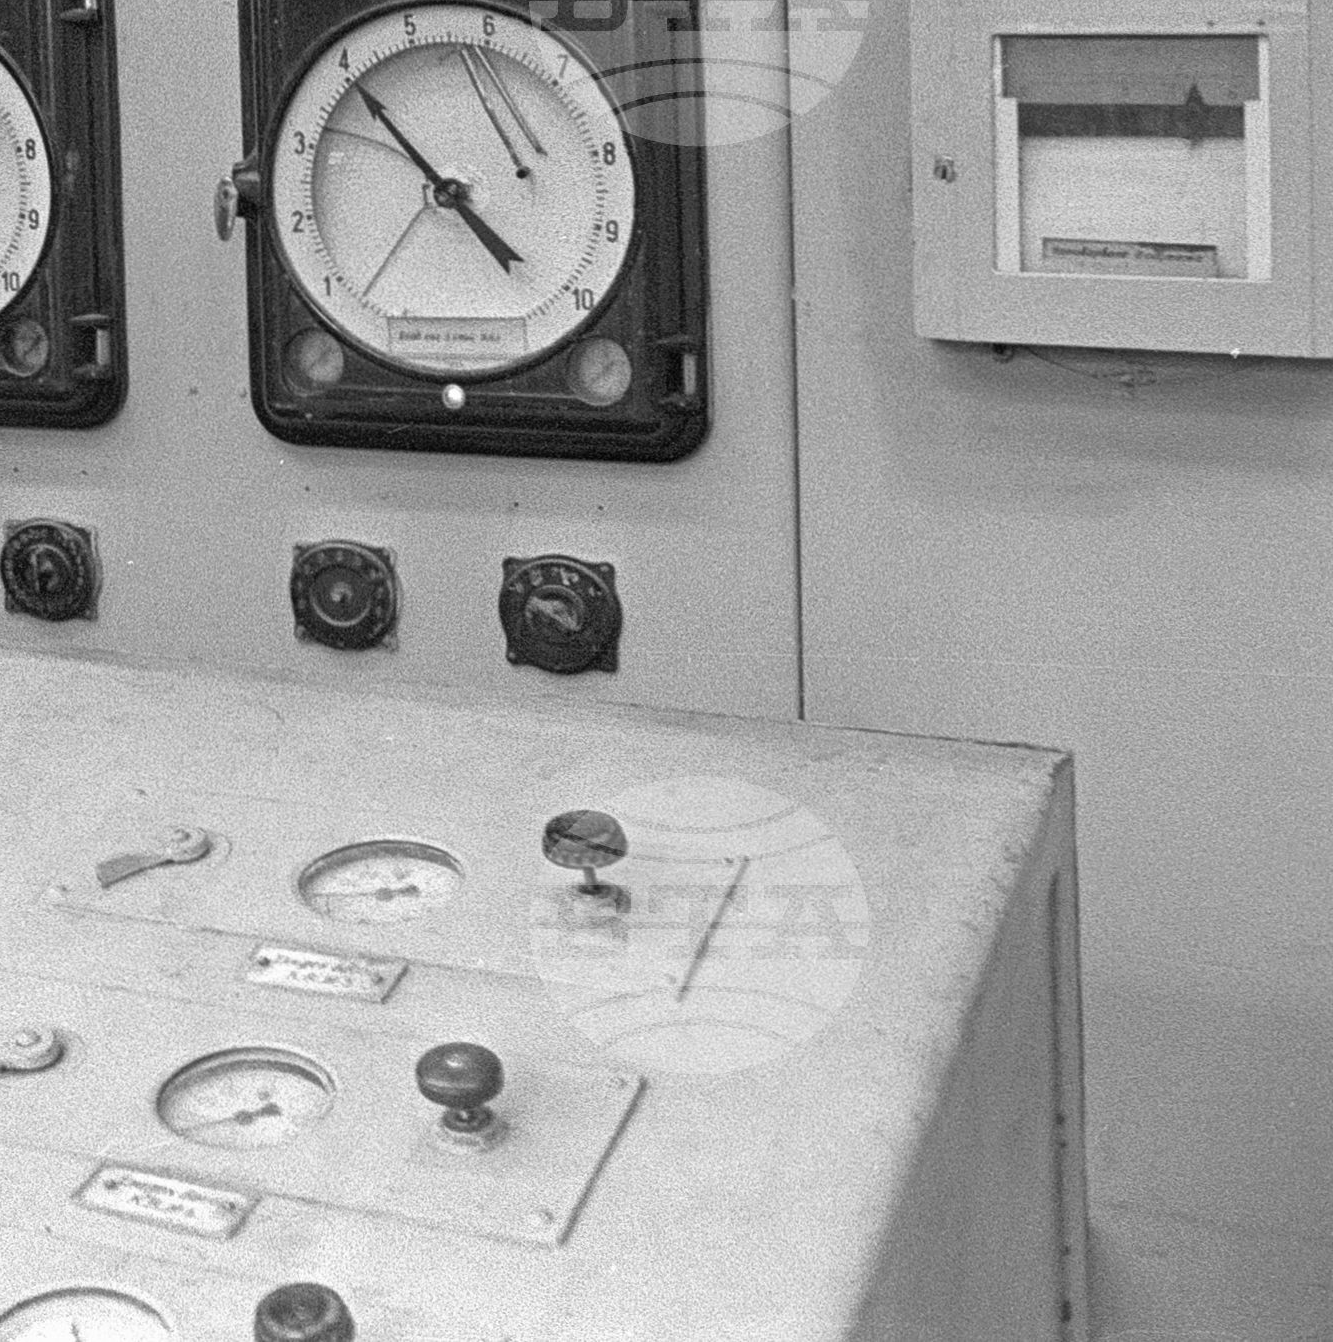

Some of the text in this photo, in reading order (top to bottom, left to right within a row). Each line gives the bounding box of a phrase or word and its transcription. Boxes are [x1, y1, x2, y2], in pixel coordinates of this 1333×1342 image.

[404, 15, 417, 36] 5
[483, 14, 496, 36] 6
[338, 48, 351, 71] 4
[24, 139, 37, 159] 8
[293, 133, 306, 155] 3
[602, 142, 616, 166] 8
[28, 210, 40, 231] 9
[291, 211, 304, 233] 2
[605, 221, 619, 244] 9
[1, 272, 20, 293] 10
[322, 275, 331, 296] 1
[572, 287, 595, 311] 10
